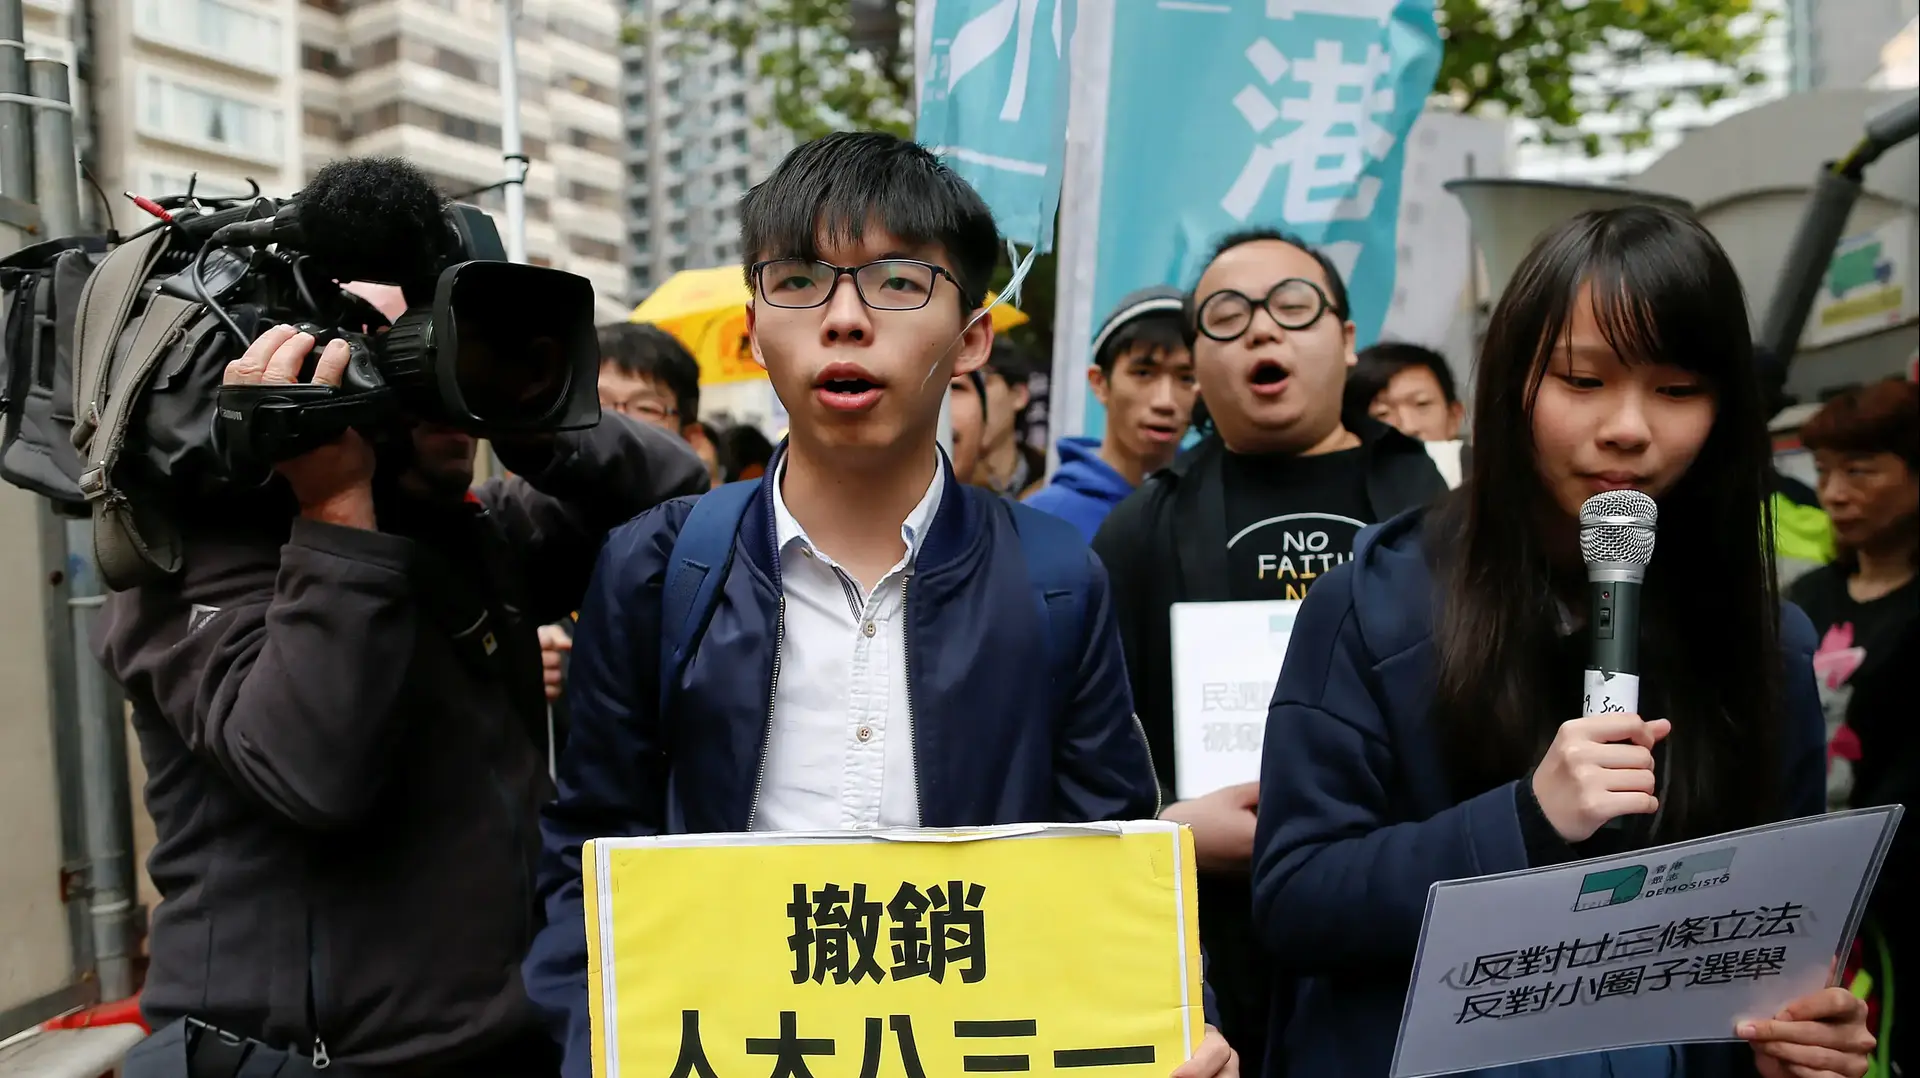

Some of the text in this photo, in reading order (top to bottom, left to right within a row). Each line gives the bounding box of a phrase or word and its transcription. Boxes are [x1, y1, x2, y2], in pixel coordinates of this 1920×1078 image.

[1283, 531, 1329, 552] NO
[786, 880, 988, 986] 撤銷
[1465, 901, 1803, 987] 反對廿三條立法
[1455, 945, 1787, 1025] 反對小圈子選舉
[668, 1009, 1156, 1078] 人大八三一
